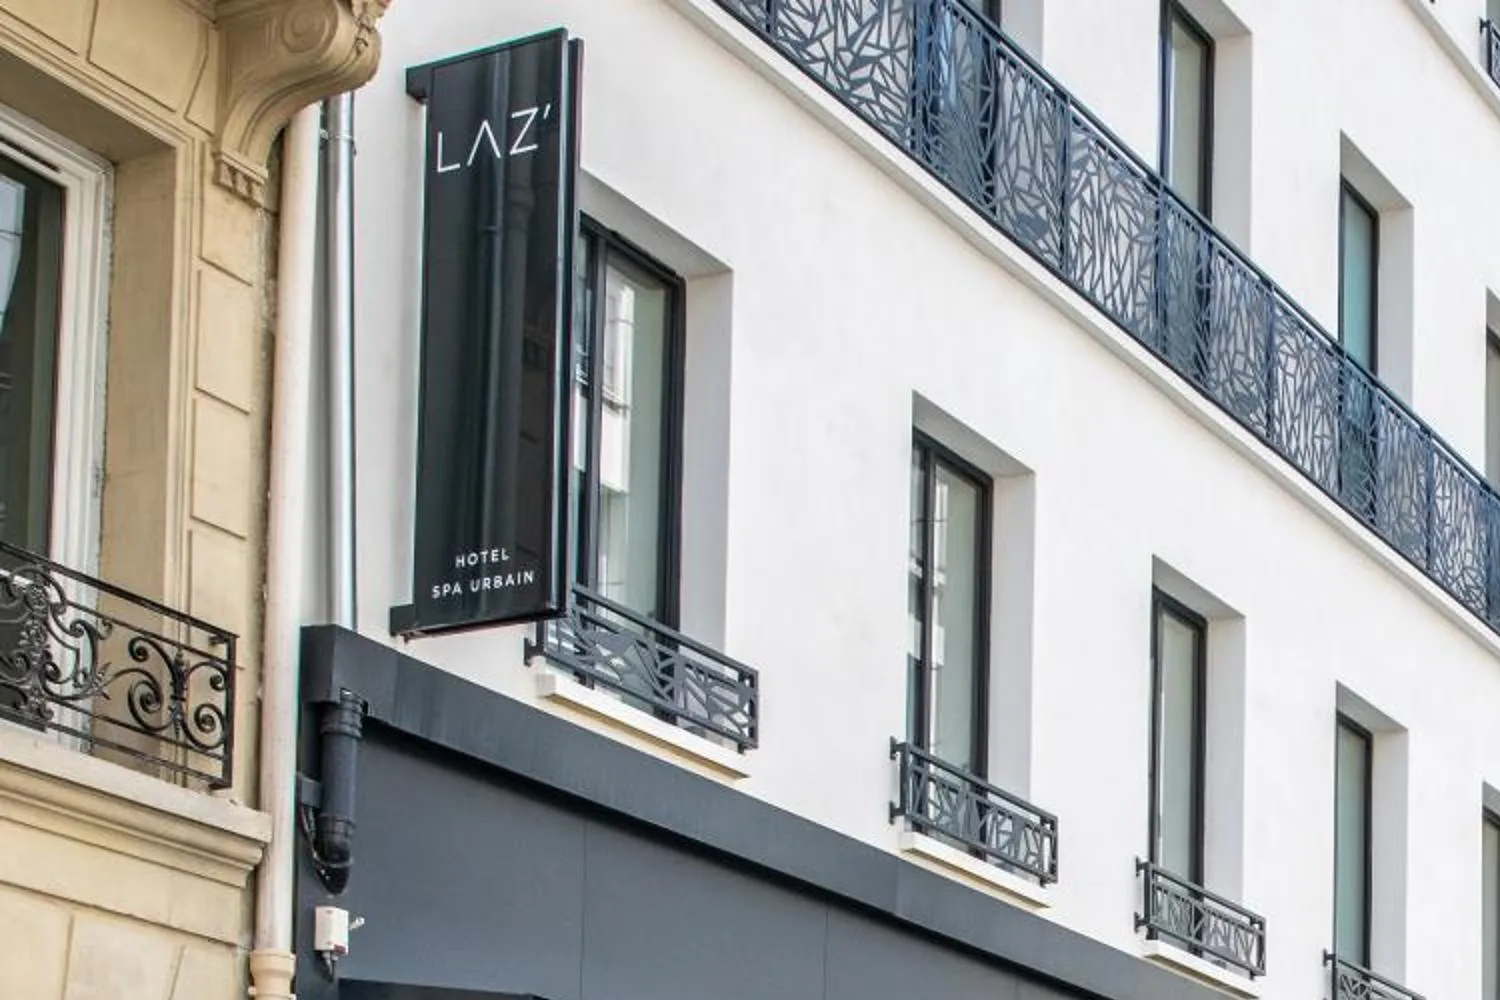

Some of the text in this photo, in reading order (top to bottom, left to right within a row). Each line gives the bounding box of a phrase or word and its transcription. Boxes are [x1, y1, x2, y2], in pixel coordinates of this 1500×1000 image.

[455, 547, 511, 569] HOTEL
[431, 570, 534, 599] SPA URBAIN
